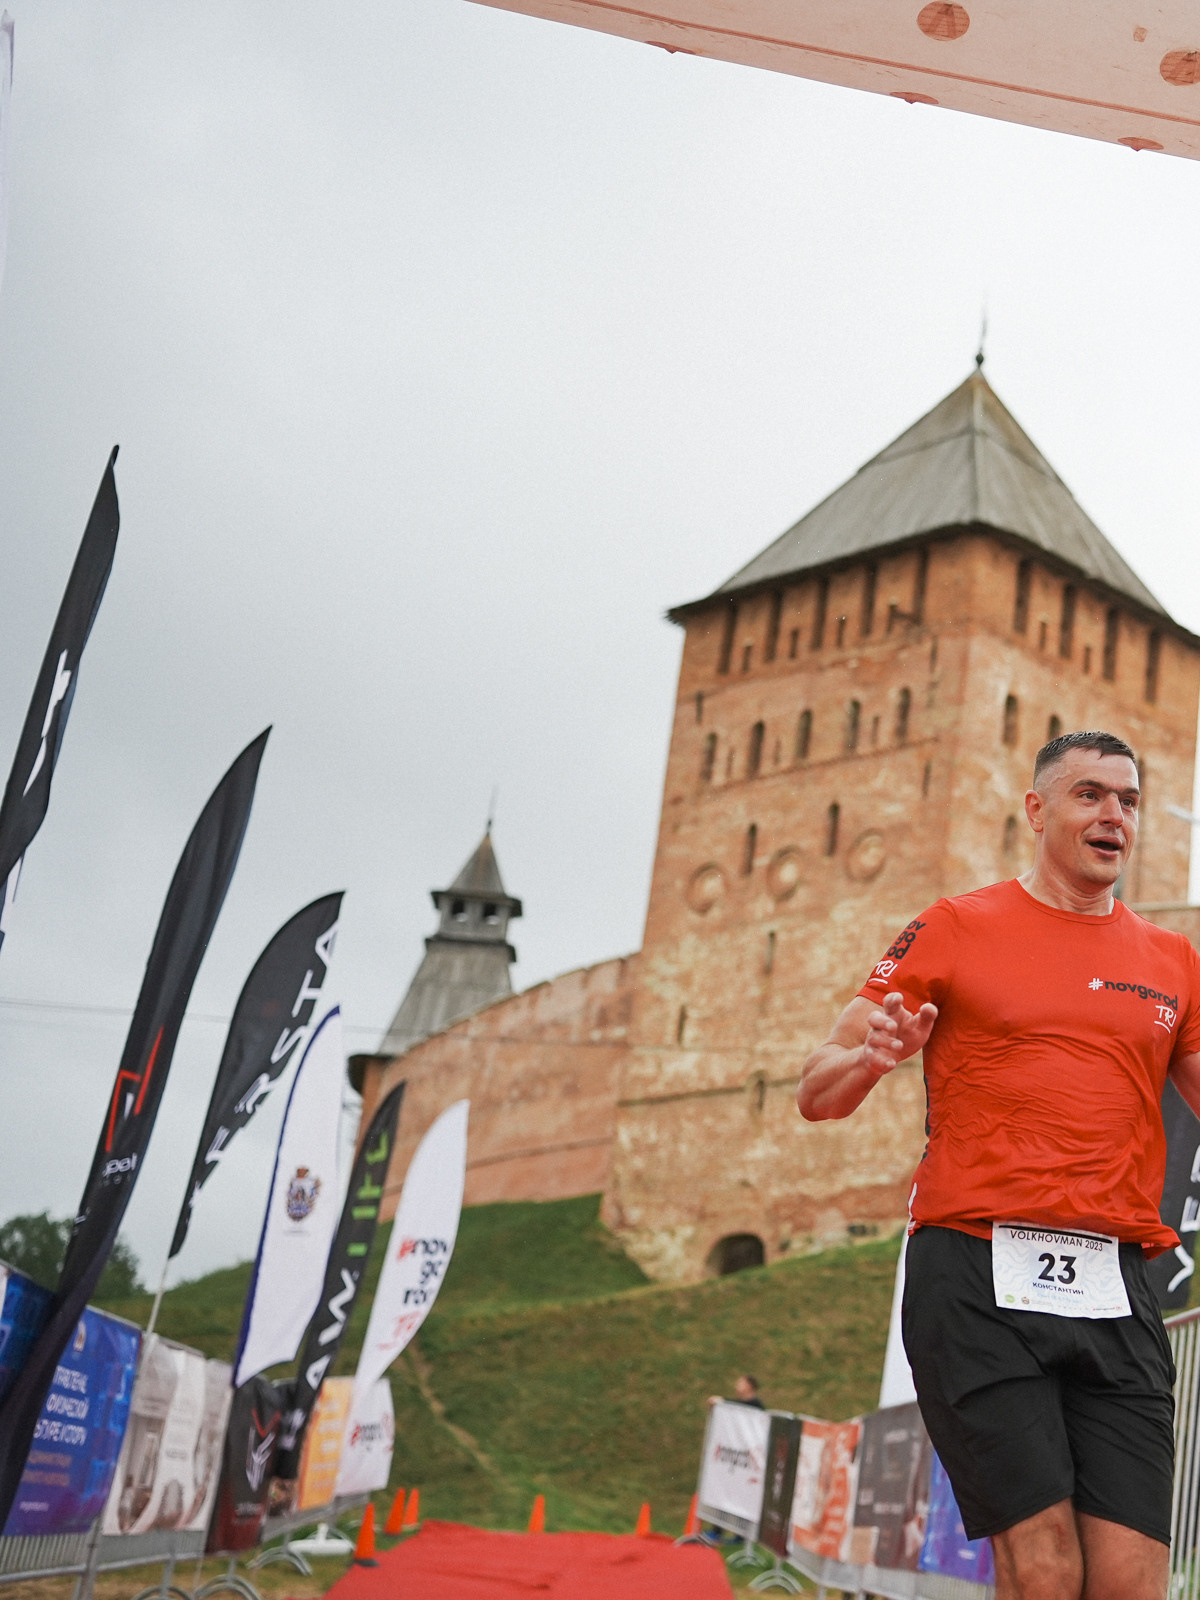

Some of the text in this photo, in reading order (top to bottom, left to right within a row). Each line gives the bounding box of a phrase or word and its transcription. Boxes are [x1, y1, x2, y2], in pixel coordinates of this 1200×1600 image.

[907, 920, 926, 931] ov
[895, 931, 916, 945] go
[887, 943, 911, 959] od
[876, 960, 898, 977] TRI
[1088, 977, 1177, 1011] #novgorod
[1155, 1005, 1177, 1028] TRI
[1010, 1230, 1103, 1251] VOLKHOVMAN 2023
[1038, 1252, 1077, 1284] 23
[1032, 1282, 1084, 1295] КОНСТАНТИН
